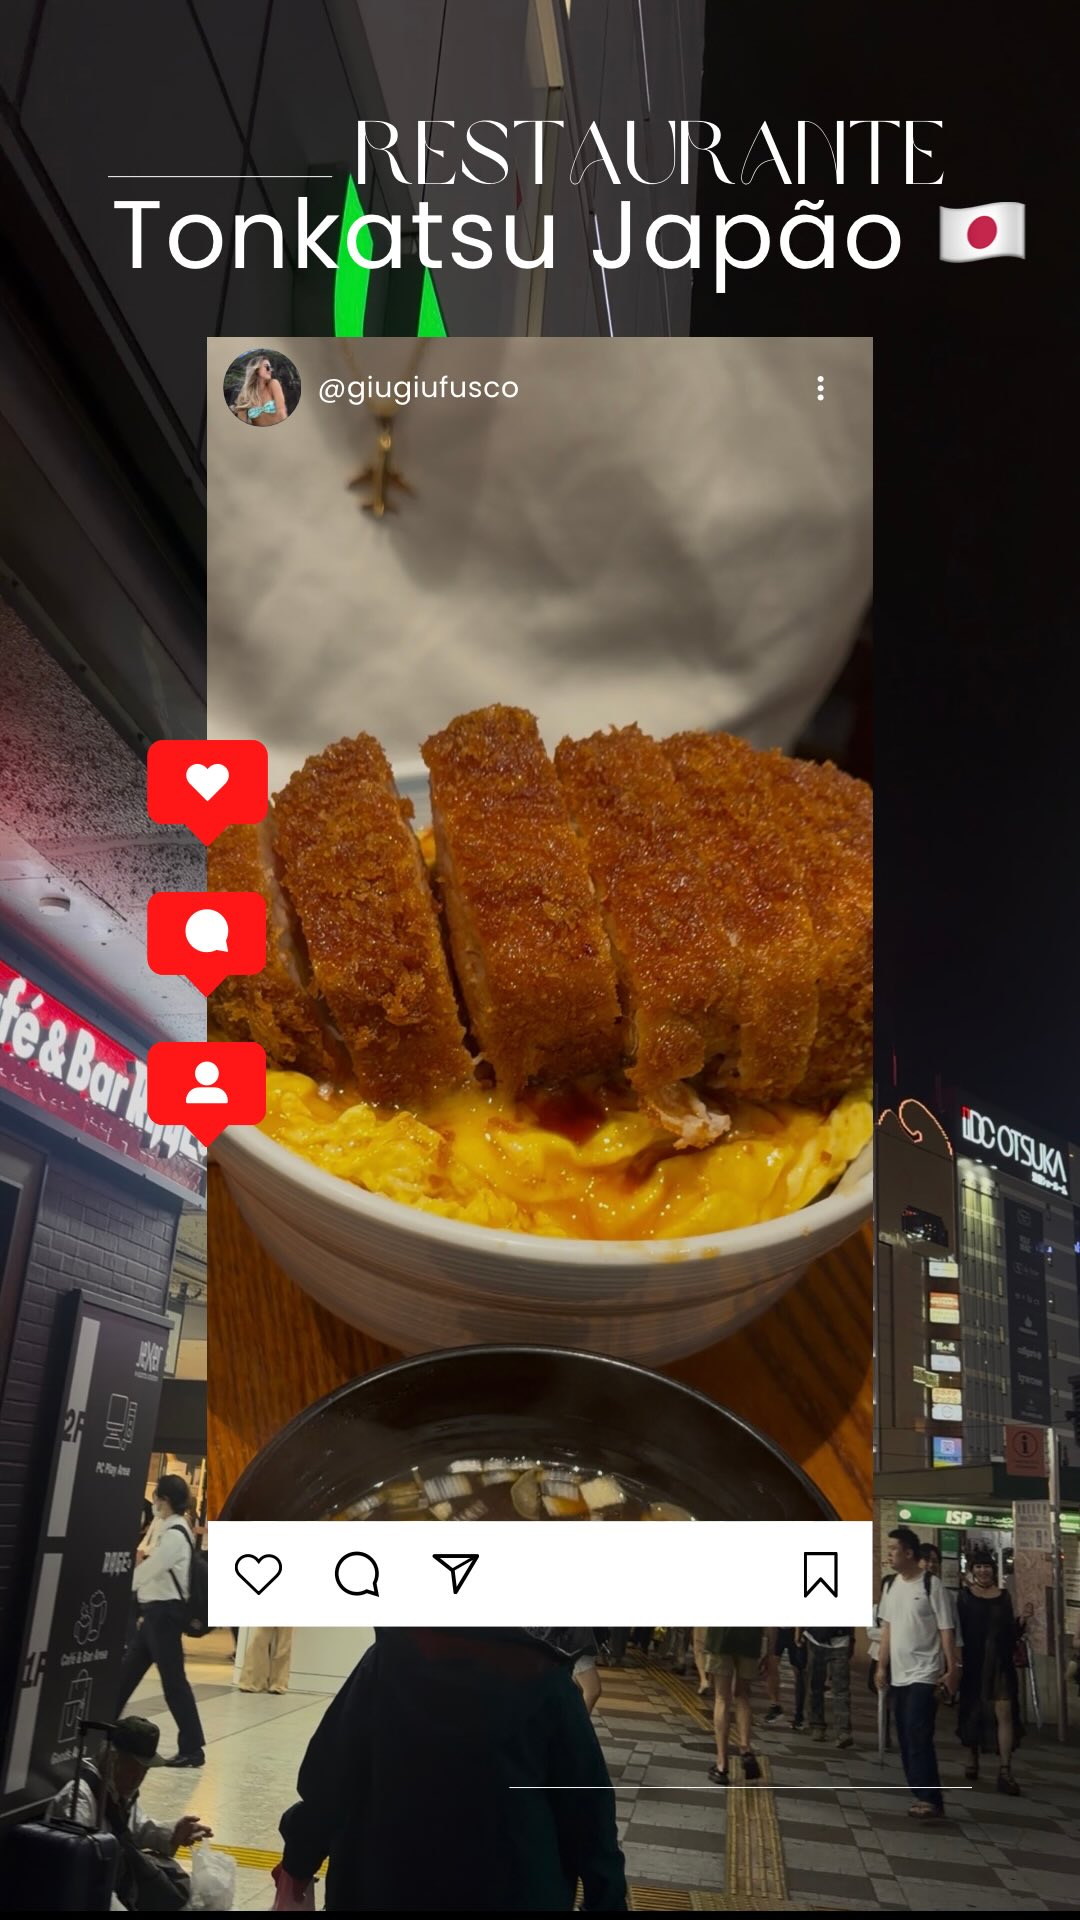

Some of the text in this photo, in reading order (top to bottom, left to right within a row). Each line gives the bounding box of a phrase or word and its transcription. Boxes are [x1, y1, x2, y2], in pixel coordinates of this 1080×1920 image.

[39, 1019, 68, 1080] &
[66, 1028, 130, 1112] Bar
[996, 1124, 1068, 1183] OTSUKA
[63, 1408, 86, 1443] 2F
[945, 1510, 973, 1526] ISP
